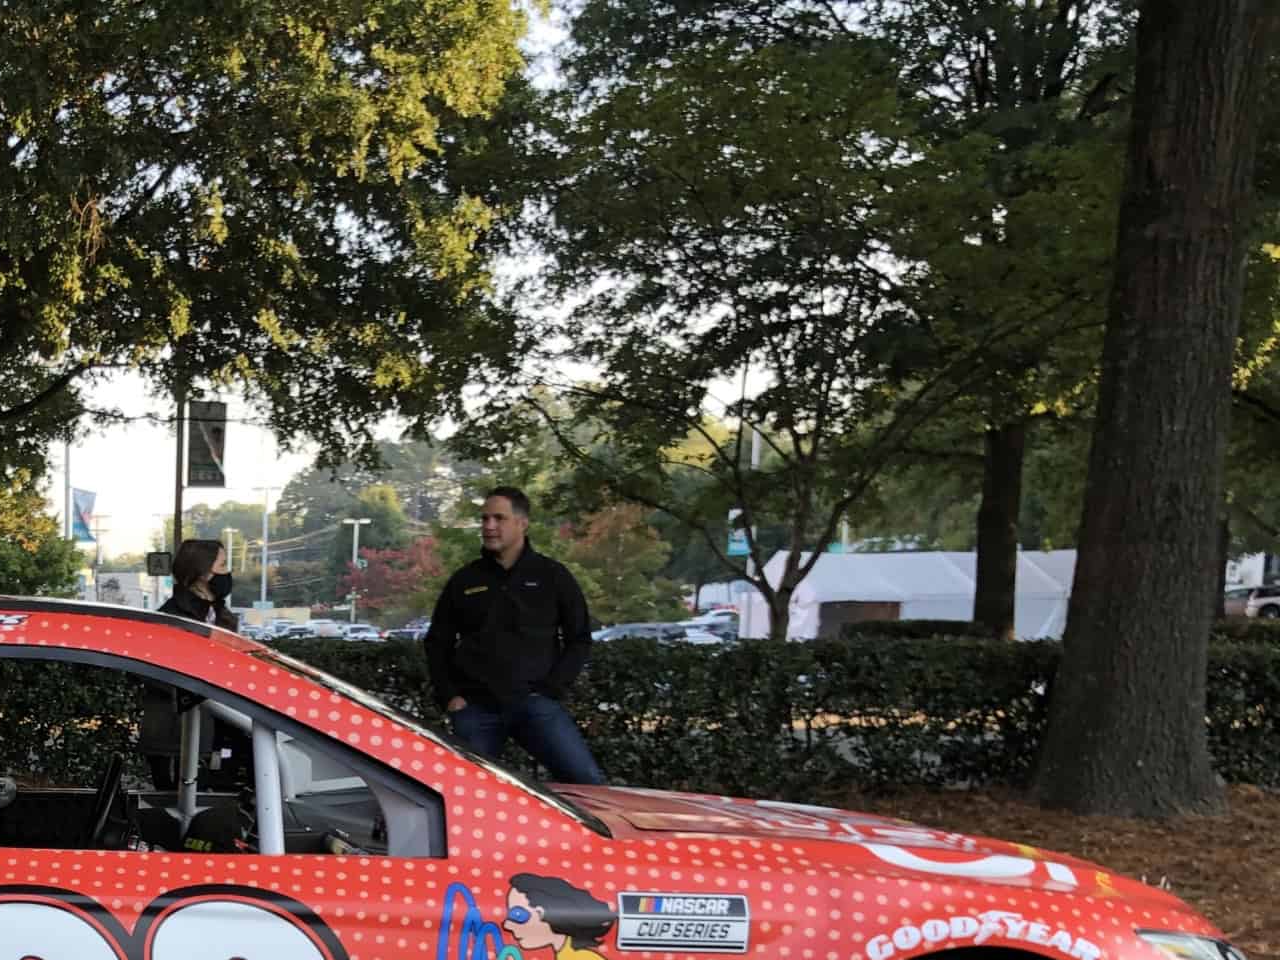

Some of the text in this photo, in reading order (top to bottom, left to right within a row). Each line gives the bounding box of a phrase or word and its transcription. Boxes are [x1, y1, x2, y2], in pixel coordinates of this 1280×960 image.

[660, 897, 731, 915] NASCAR
[637, 922, 731, 939] CUP SERIES
